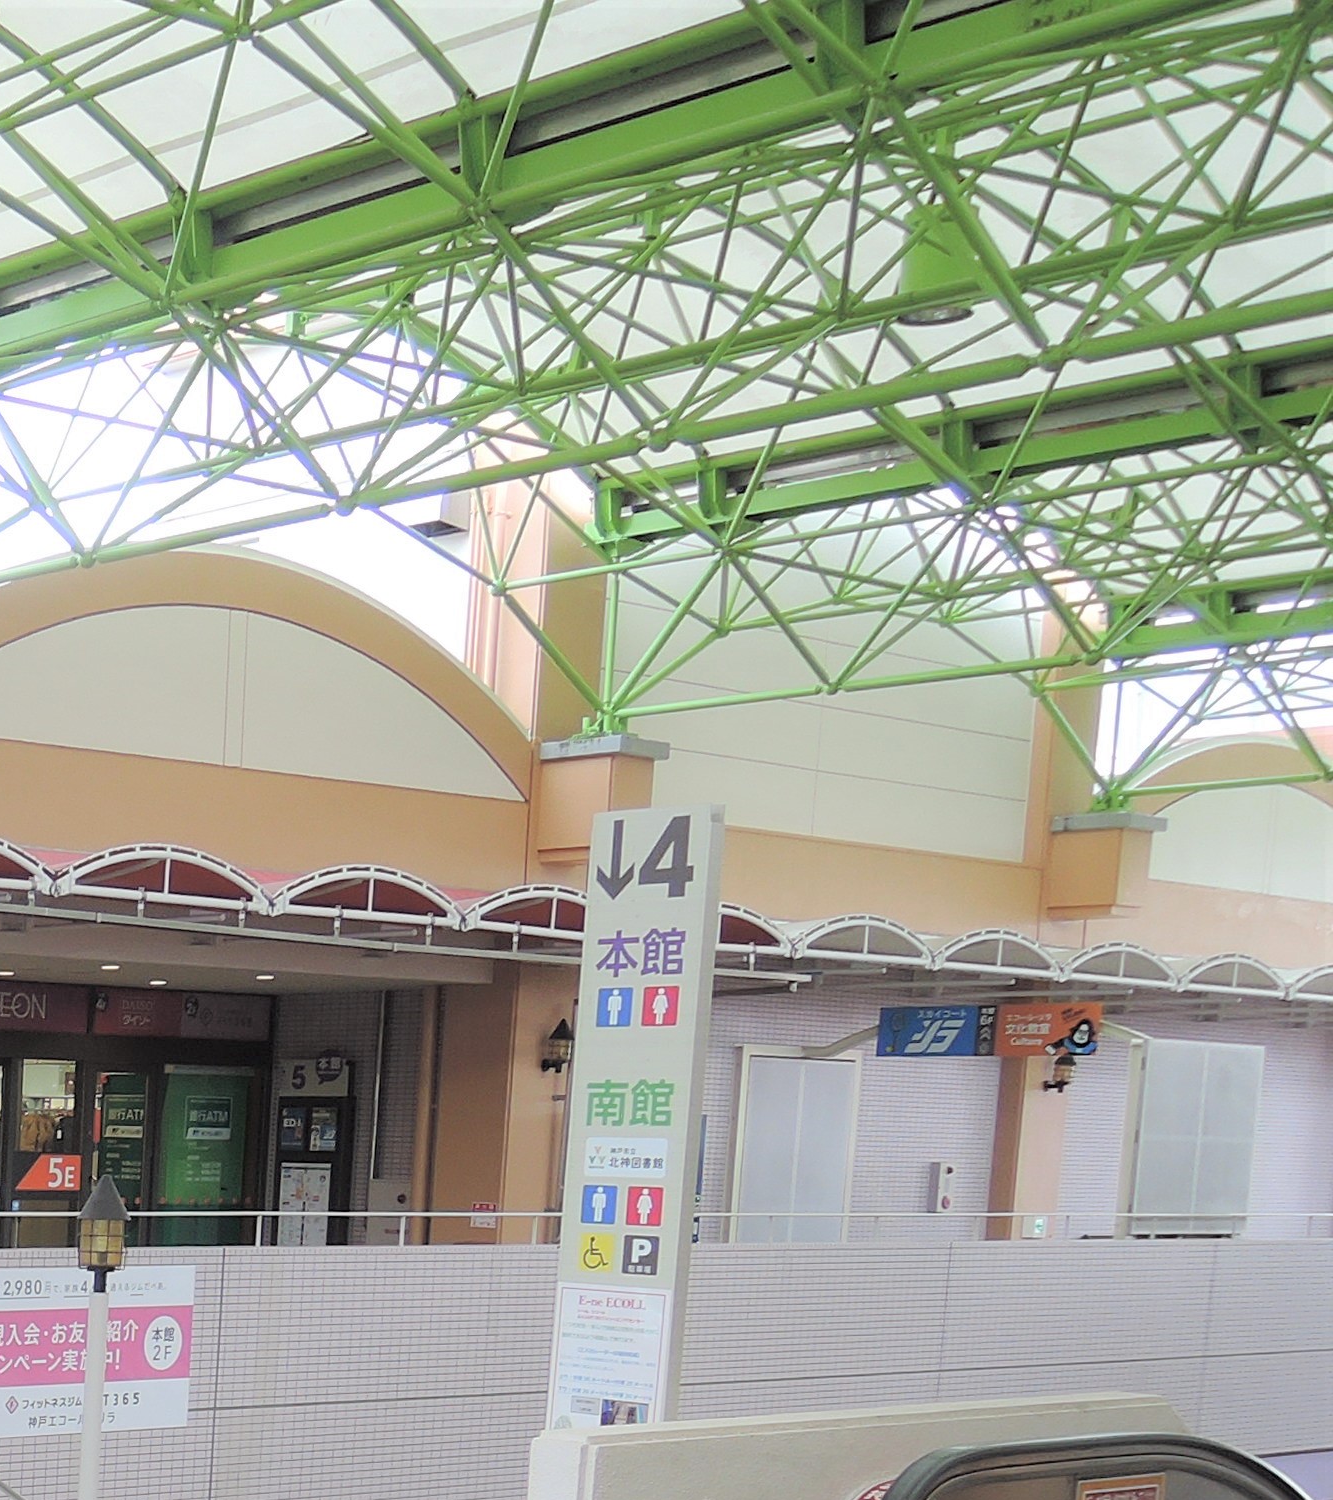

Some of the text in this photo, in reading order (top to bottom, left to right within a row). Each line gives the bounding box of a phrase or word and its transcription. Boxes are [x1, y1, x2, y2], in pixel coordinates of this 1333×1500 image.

[638, 815, 694, 898] 4
[596, 927, 686, 978] 本館
[586, 1079, 675, 1127] 南館
[47, 1156, 75, 1188] 5E
[609, 1157, 664, 1170] 北神図書館
[151, 1326, 175, 1343] 本館
[152, 1346, 173, 1361] 2F
